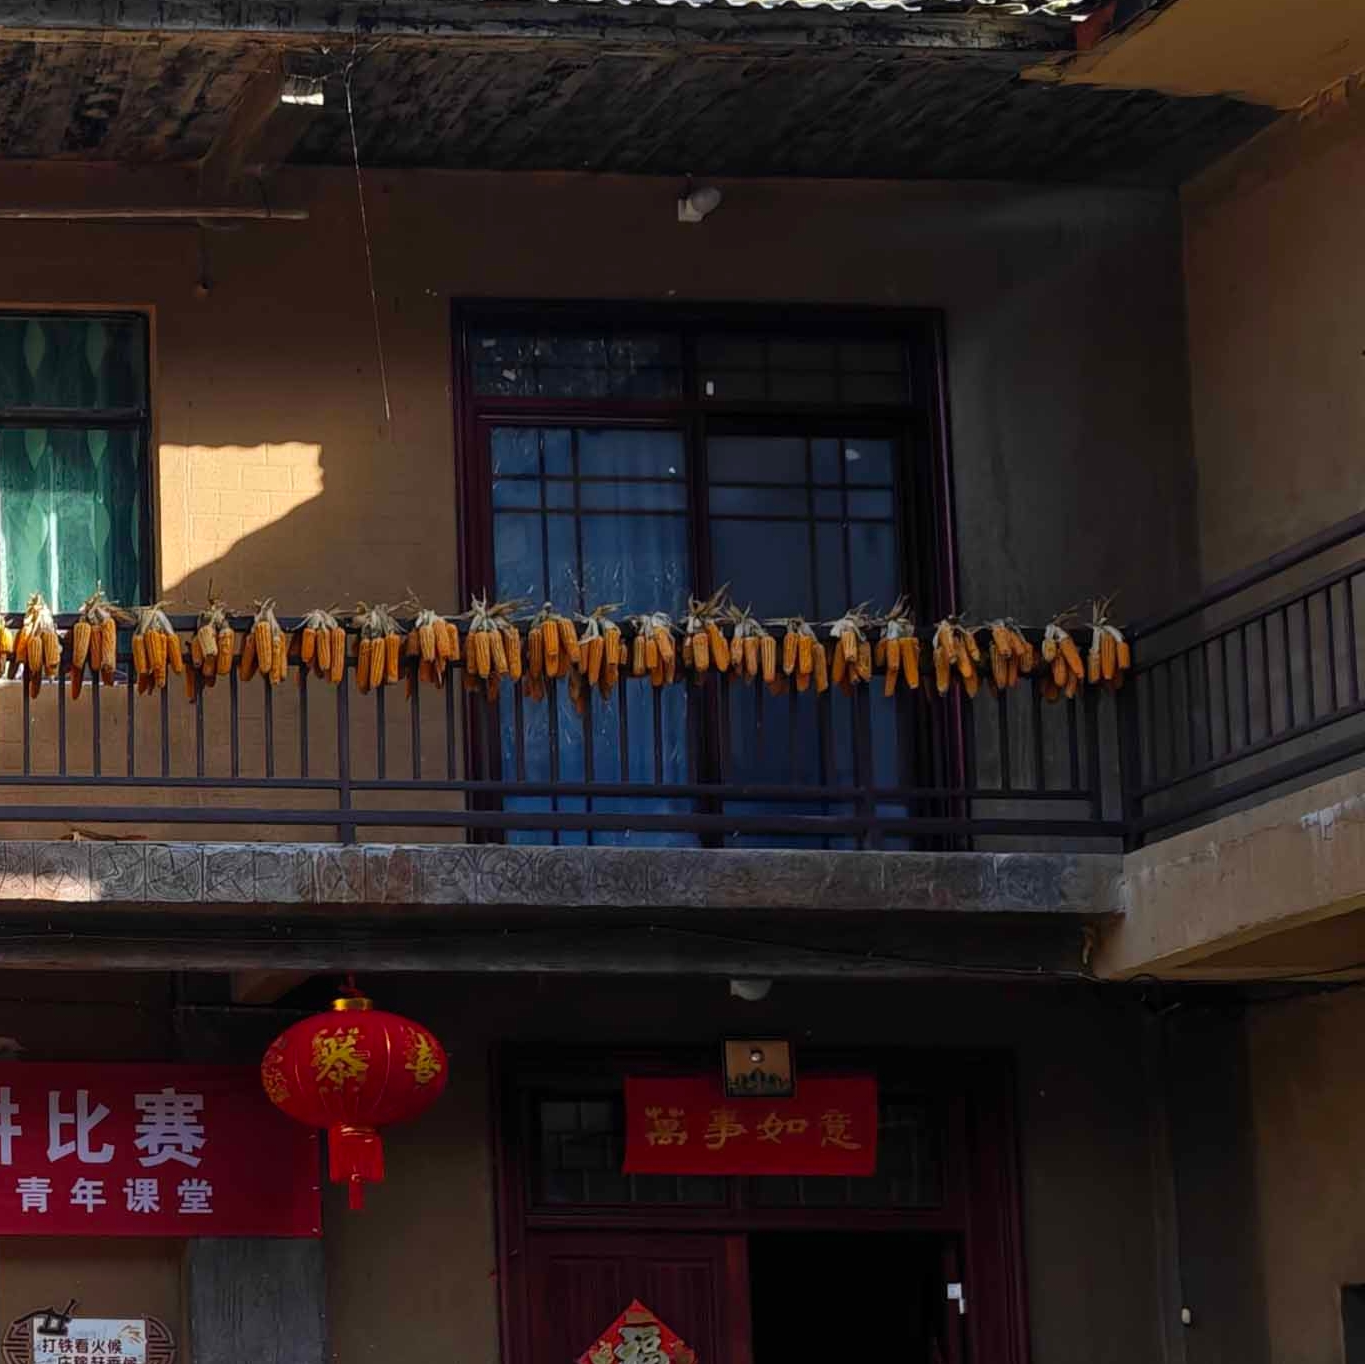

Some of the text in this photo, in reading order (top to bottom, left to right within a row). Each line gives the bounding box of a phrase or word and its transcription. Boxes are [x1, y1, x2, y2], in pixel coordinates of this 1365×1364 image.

[42, 1338, 123, 1354] 打铁看火候
